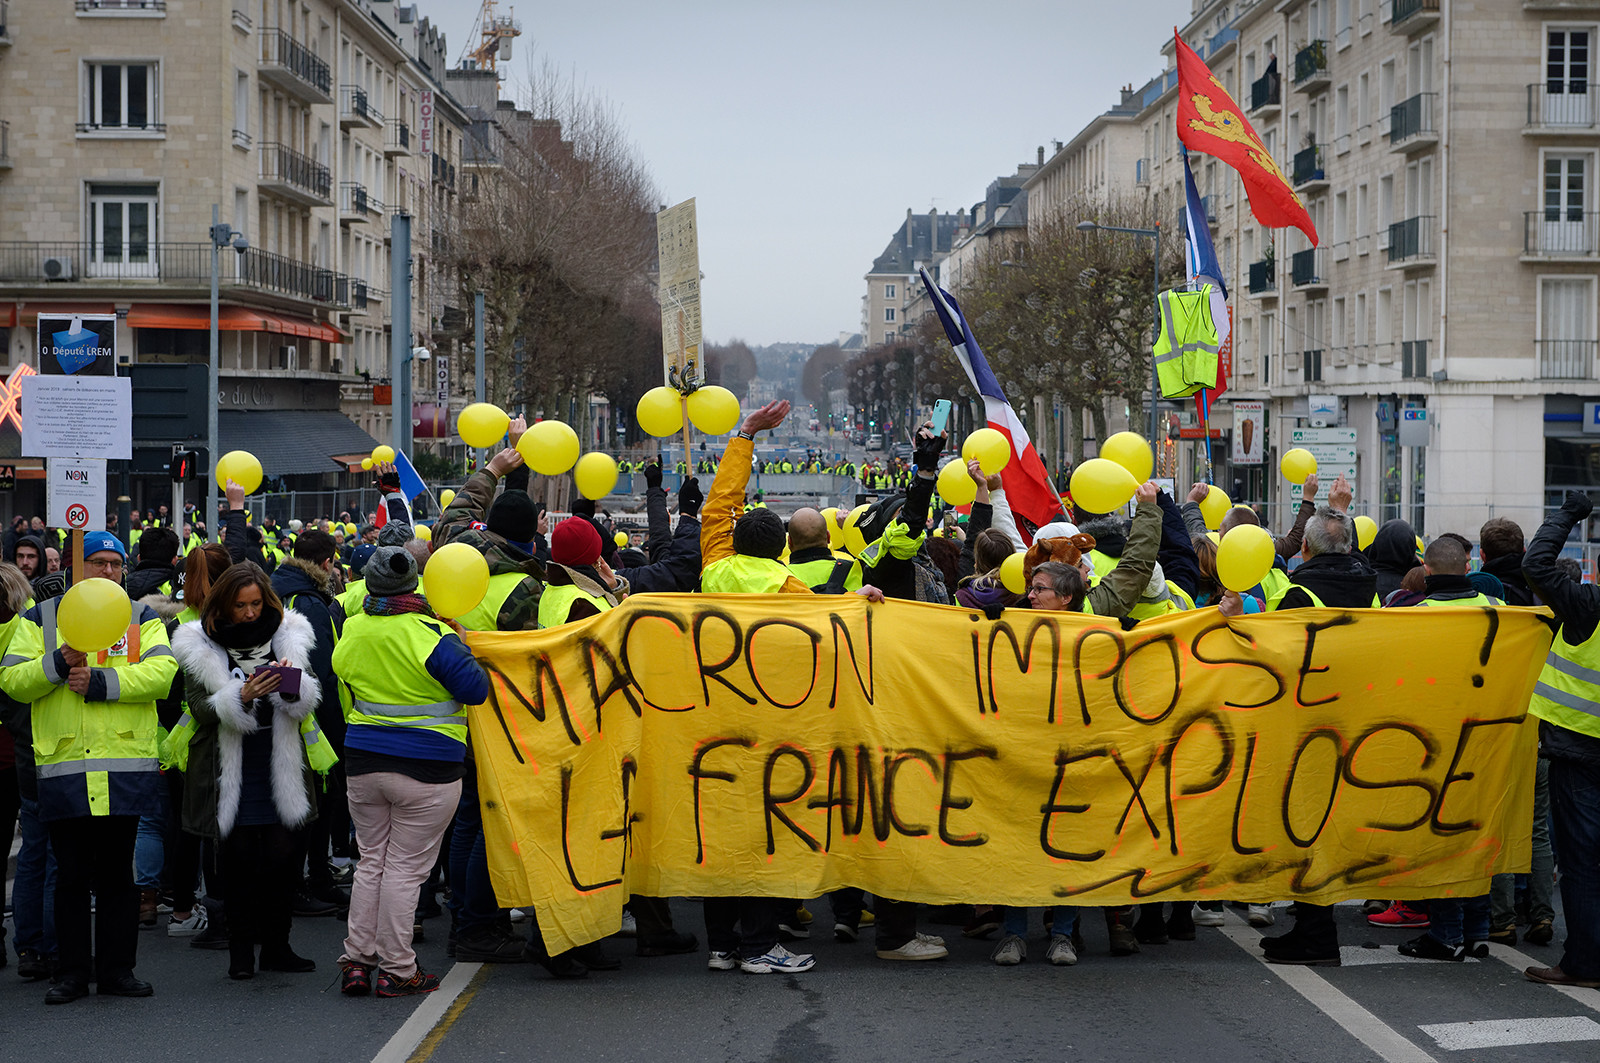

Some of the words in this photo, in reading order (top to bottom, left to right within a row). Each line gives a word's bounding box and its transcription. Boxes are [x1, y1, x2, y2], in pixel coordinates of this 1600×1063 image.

[420, 91, 432, 153] HOTEL
[42, 346, 48, 355] 0
[52, 345, 85, 356] Député
[86, 347, 112, 356] LREM
[231, 382, 247, 405] du
[1405, 411, 1424, 419] CIC
[65, 470, 88, 481] NON
[70, 510, 84, 522] 80
[478, 606, 875, 772] MACRON
[560, 756, 643, 894] LA
[687, 737, 999, 866] FRANCE
[1039, 708, 1526, 862] EXPLOSE
